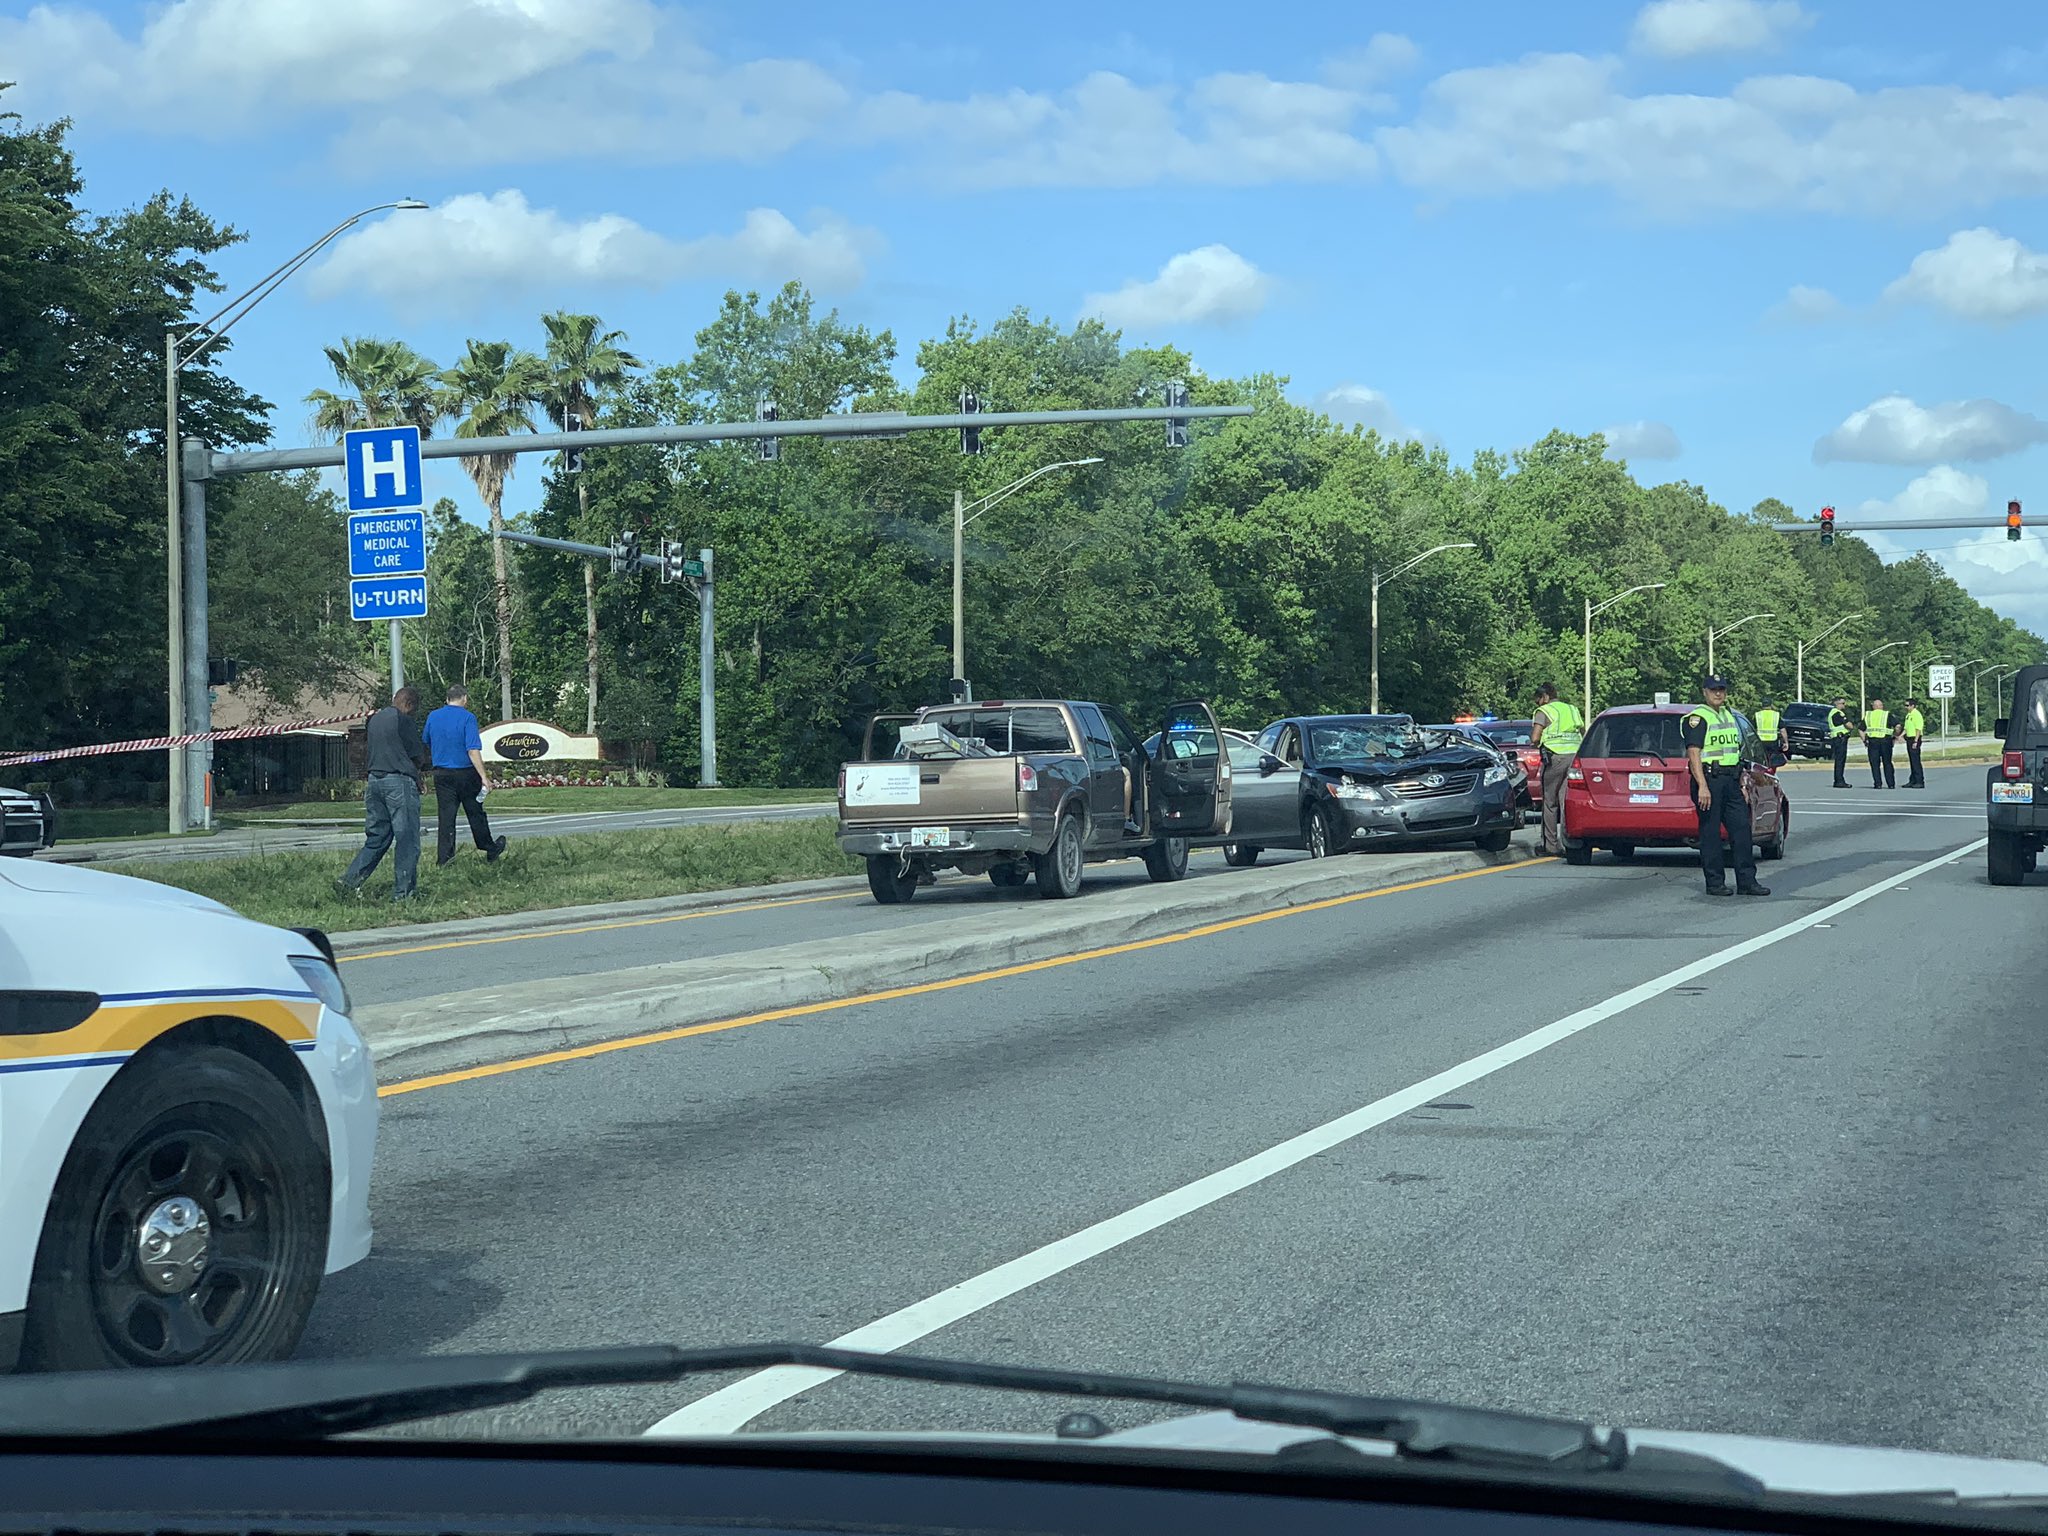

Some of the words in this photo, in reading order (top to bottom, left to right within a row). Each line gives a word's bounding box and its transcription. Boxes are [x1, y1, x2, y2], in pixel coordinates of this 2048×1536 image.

[361, 439, 407, 498] H
[354, 518, 418, 535] EMERGENCY
[363, 537, 411, 551] MEDICAL
[374, 554, 402, 568] CARE
[354, 588, 424, 608] U-TURN
[1932, 681, 1953, 694] 45
[500, 735, 540, 748] Hawkins
[1710, 733, 1739, 746] POLIC
[518, 748, 540, 758] Cove
